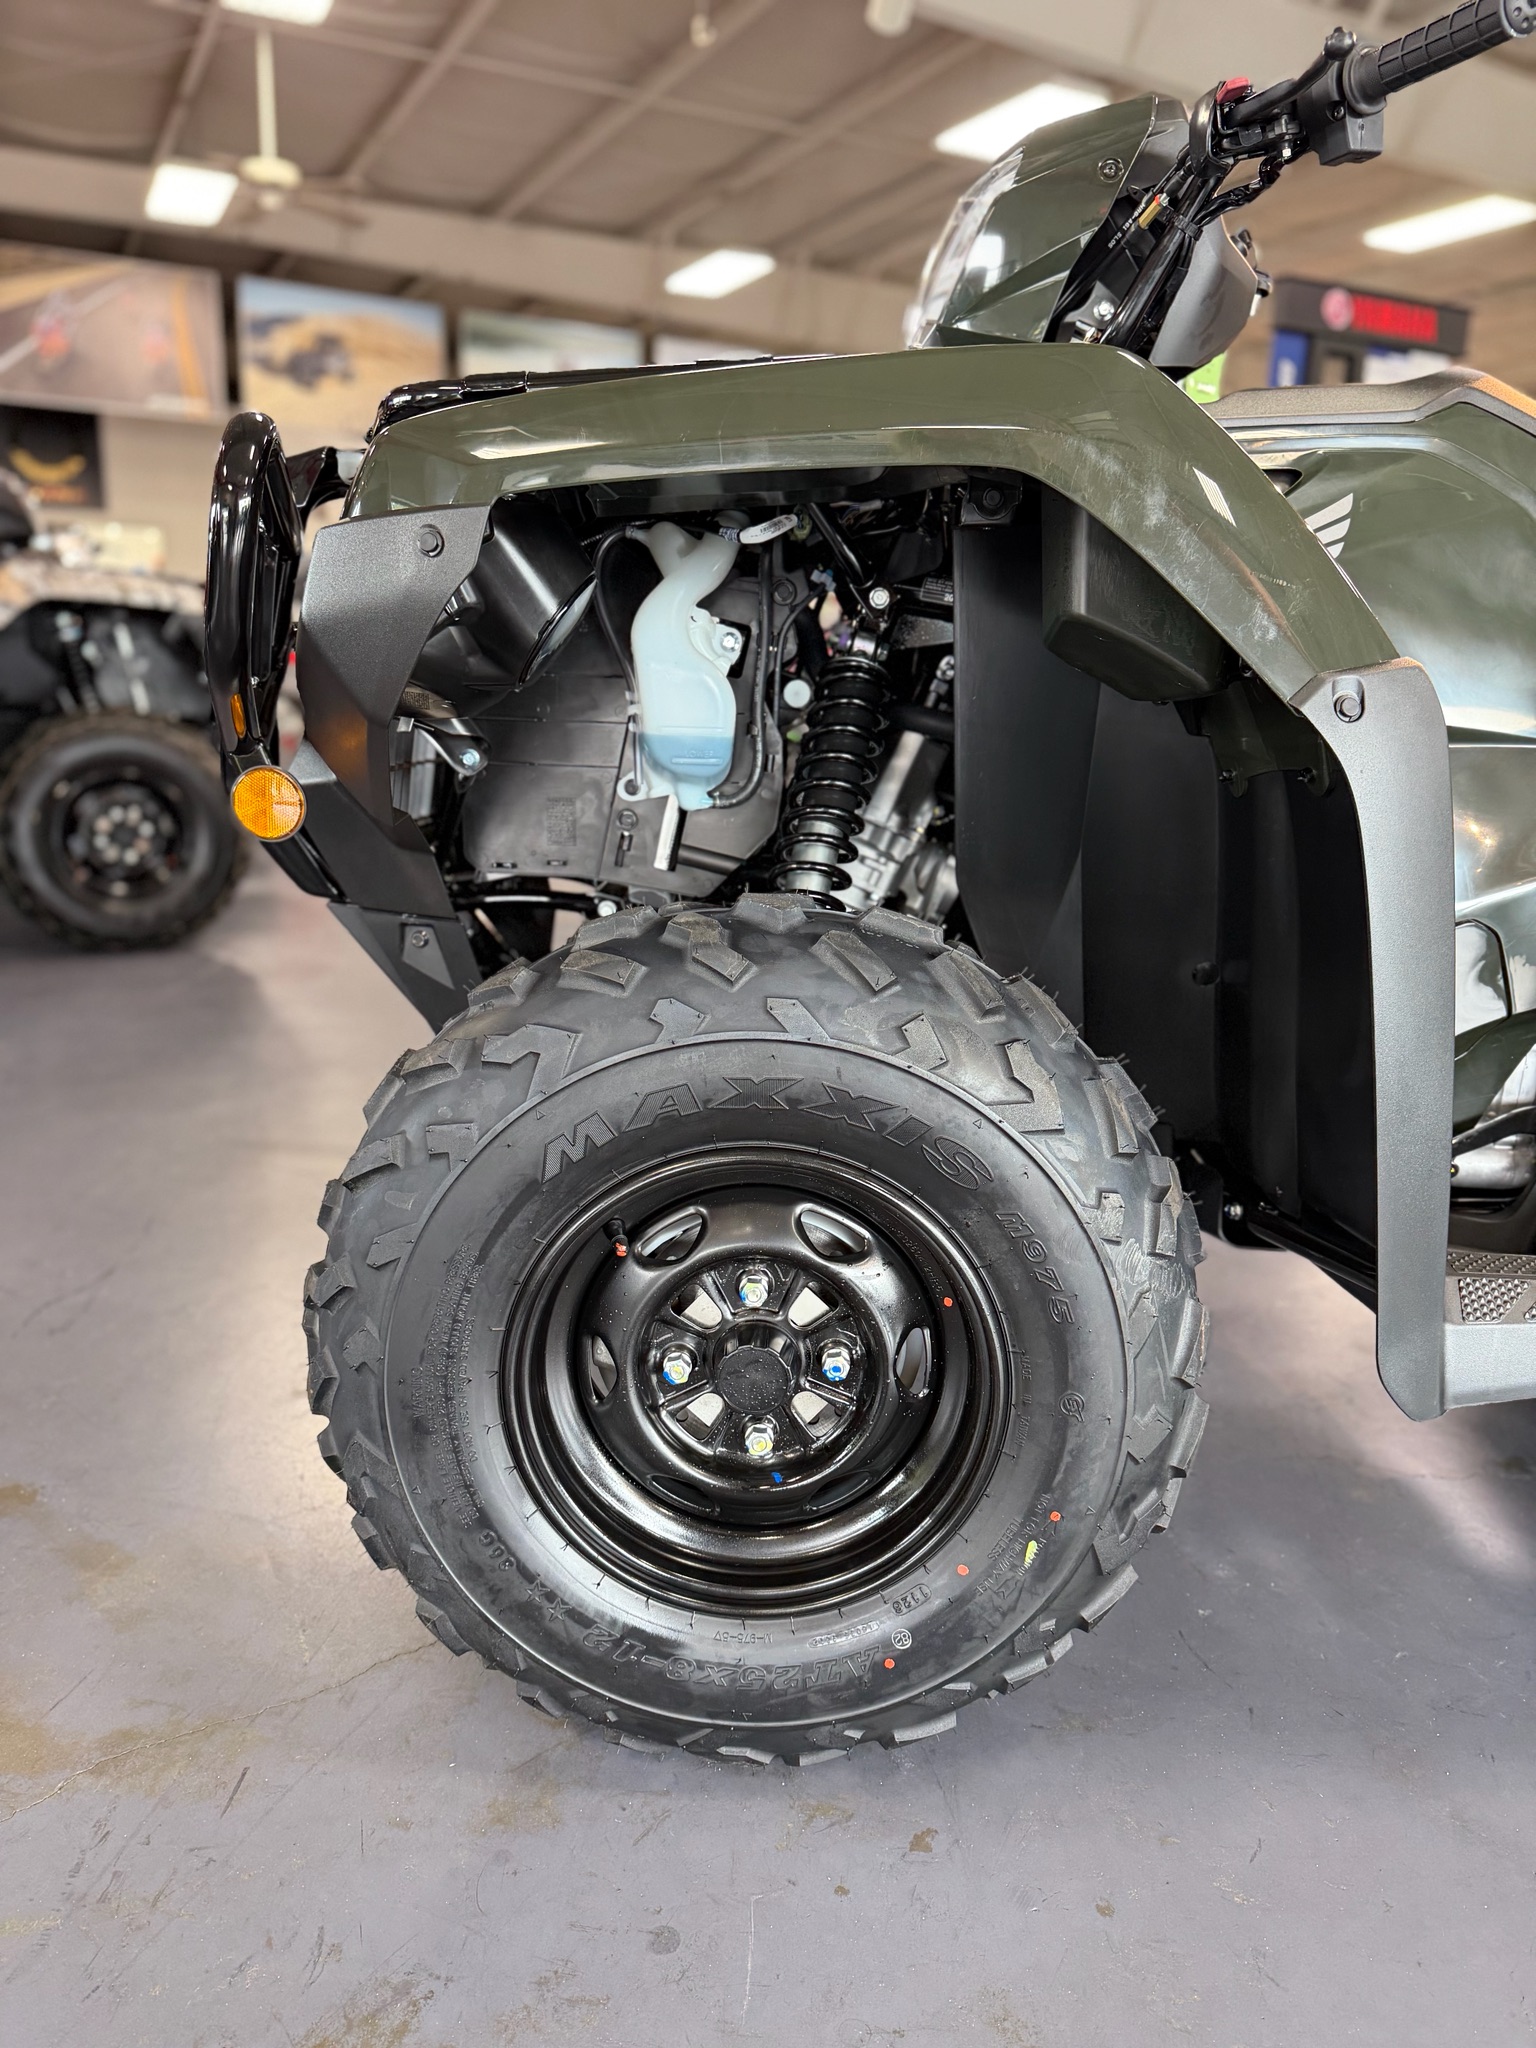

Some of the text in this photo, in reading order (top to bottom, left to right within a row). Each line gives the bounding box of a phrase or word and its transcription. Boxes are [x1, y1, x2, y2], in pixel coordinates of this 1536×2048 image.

[542, 1076, 993, 1189] MAXXIS
[995, 1212, 1075, 1326] M975
[974, 1492, 1051, 1597] NOT FOR HIGHWAY USE
[986, 1516, 1022, 1562] TUBELESS
